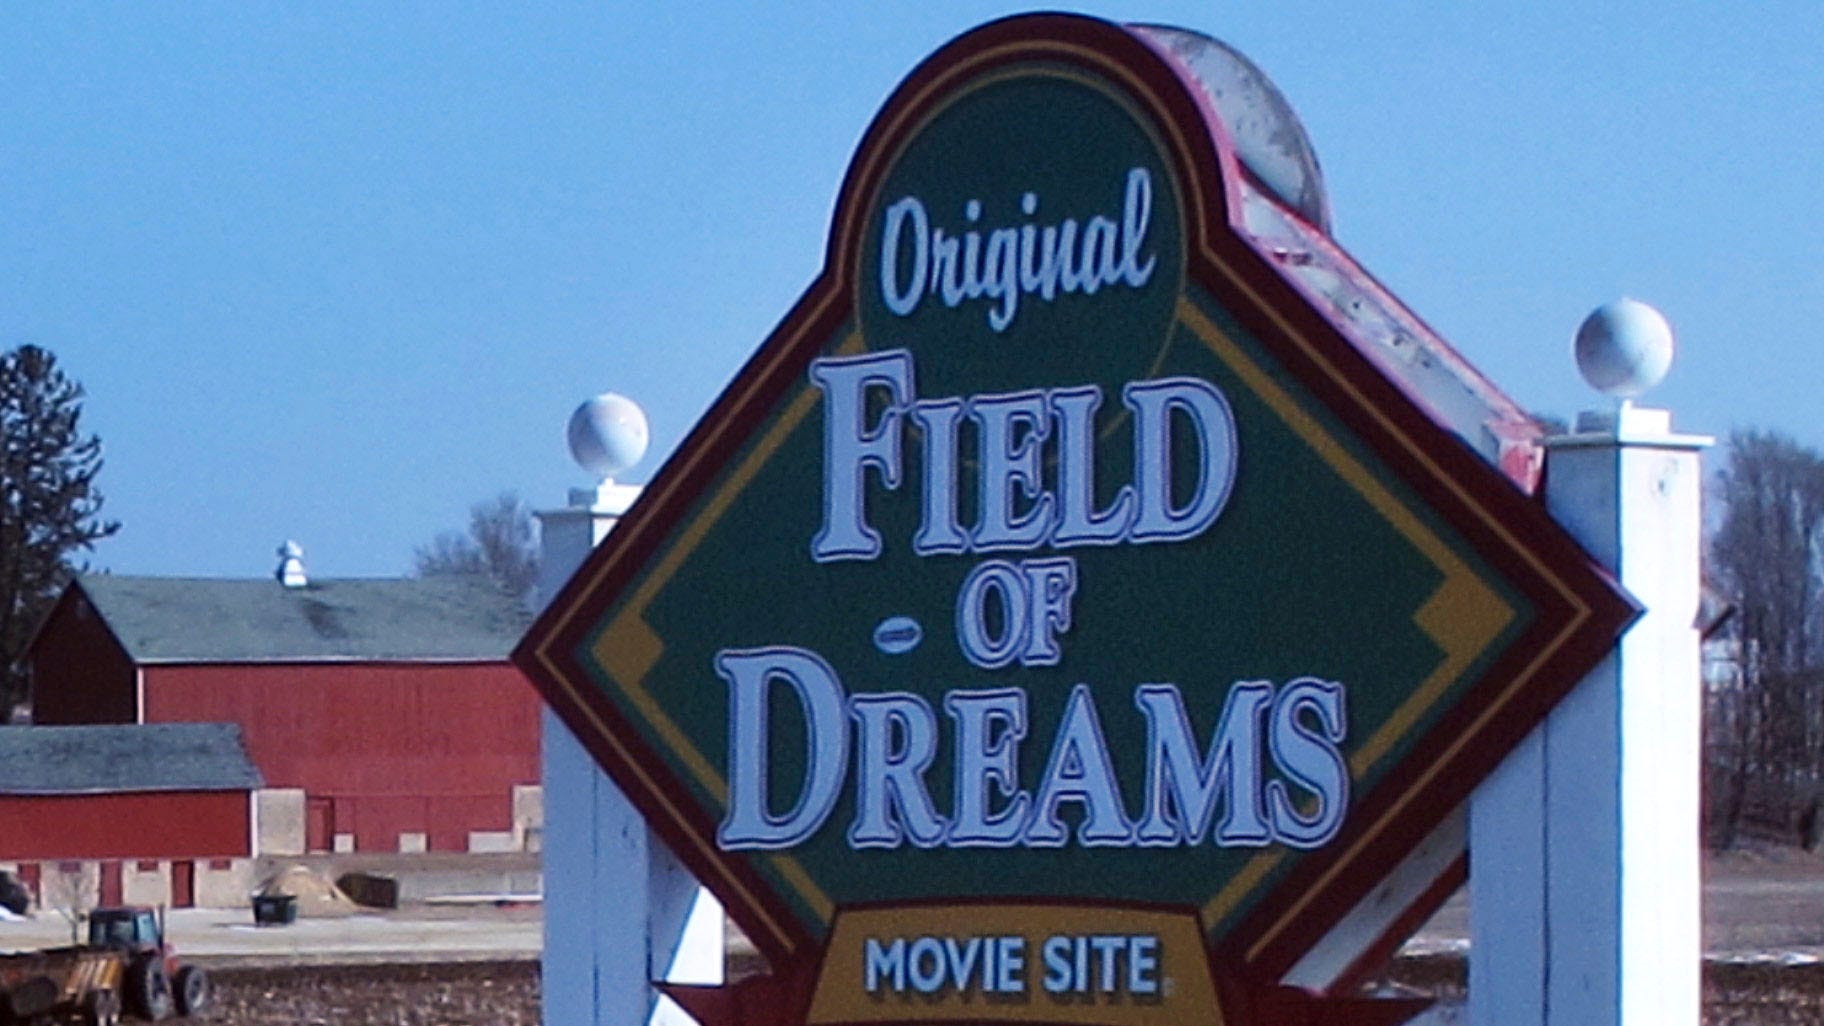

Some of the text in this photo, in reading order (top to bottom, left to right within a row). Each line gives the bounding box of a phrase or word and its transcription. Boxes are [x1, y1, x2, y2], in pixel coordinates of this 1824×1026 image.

[880, 167, 1155, 332] Original
[810, 349, 1239, 563] FIELD
[956, 556, 1075, 668] OF
[714, 645, 1350, 852] DREAMS
[864, 936, 1158, 994] MOVIE SITE
